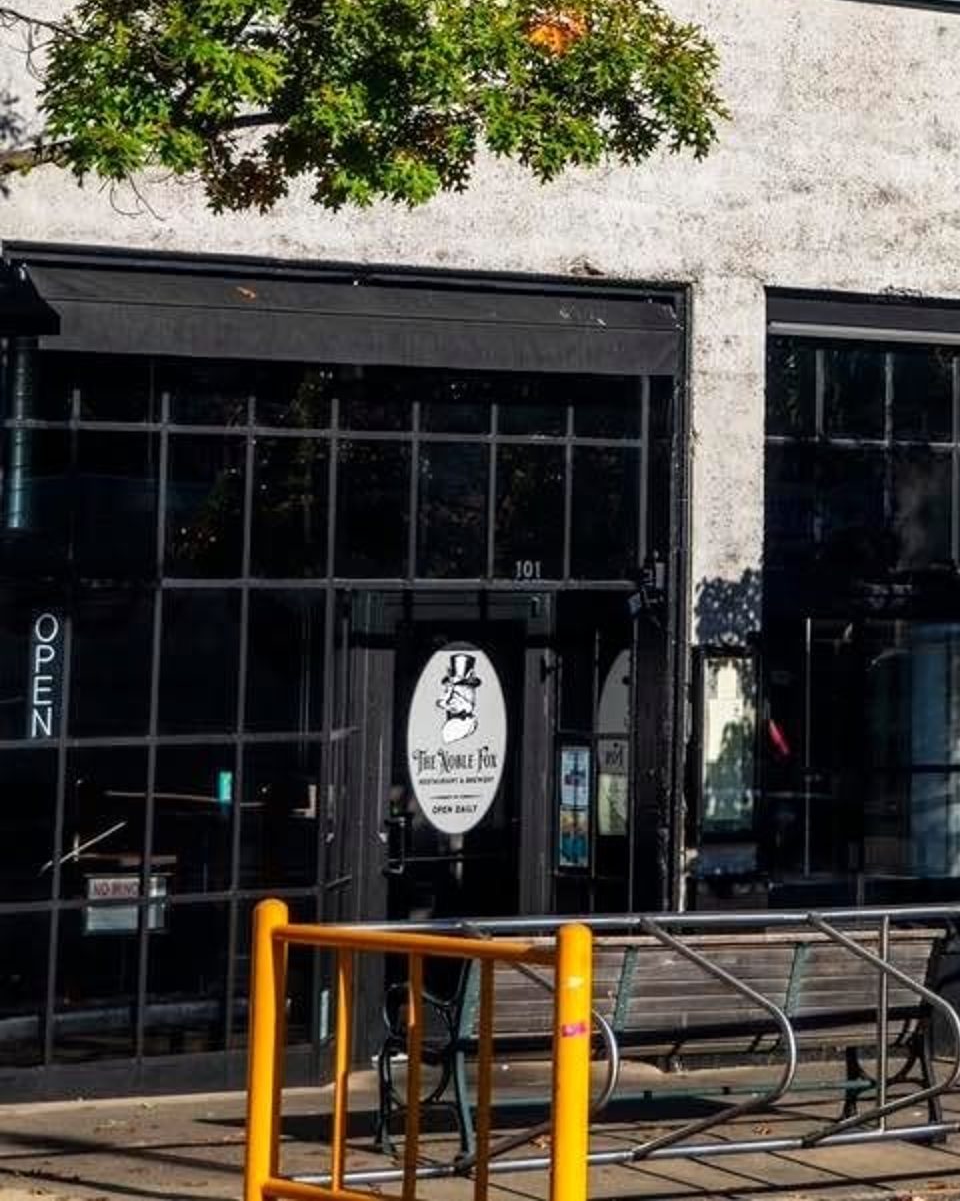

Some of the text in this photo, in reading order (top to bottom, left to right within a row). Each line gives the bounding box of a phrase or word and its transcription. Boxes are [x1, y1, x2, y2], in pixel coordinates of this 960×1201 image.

[515, 560, 541, 578] 101
[31, 612, 59, 738] OPEN
[412, 744, 497, 776] THE NOBLE FOX
[431, 804, 452, 815] OPEN
